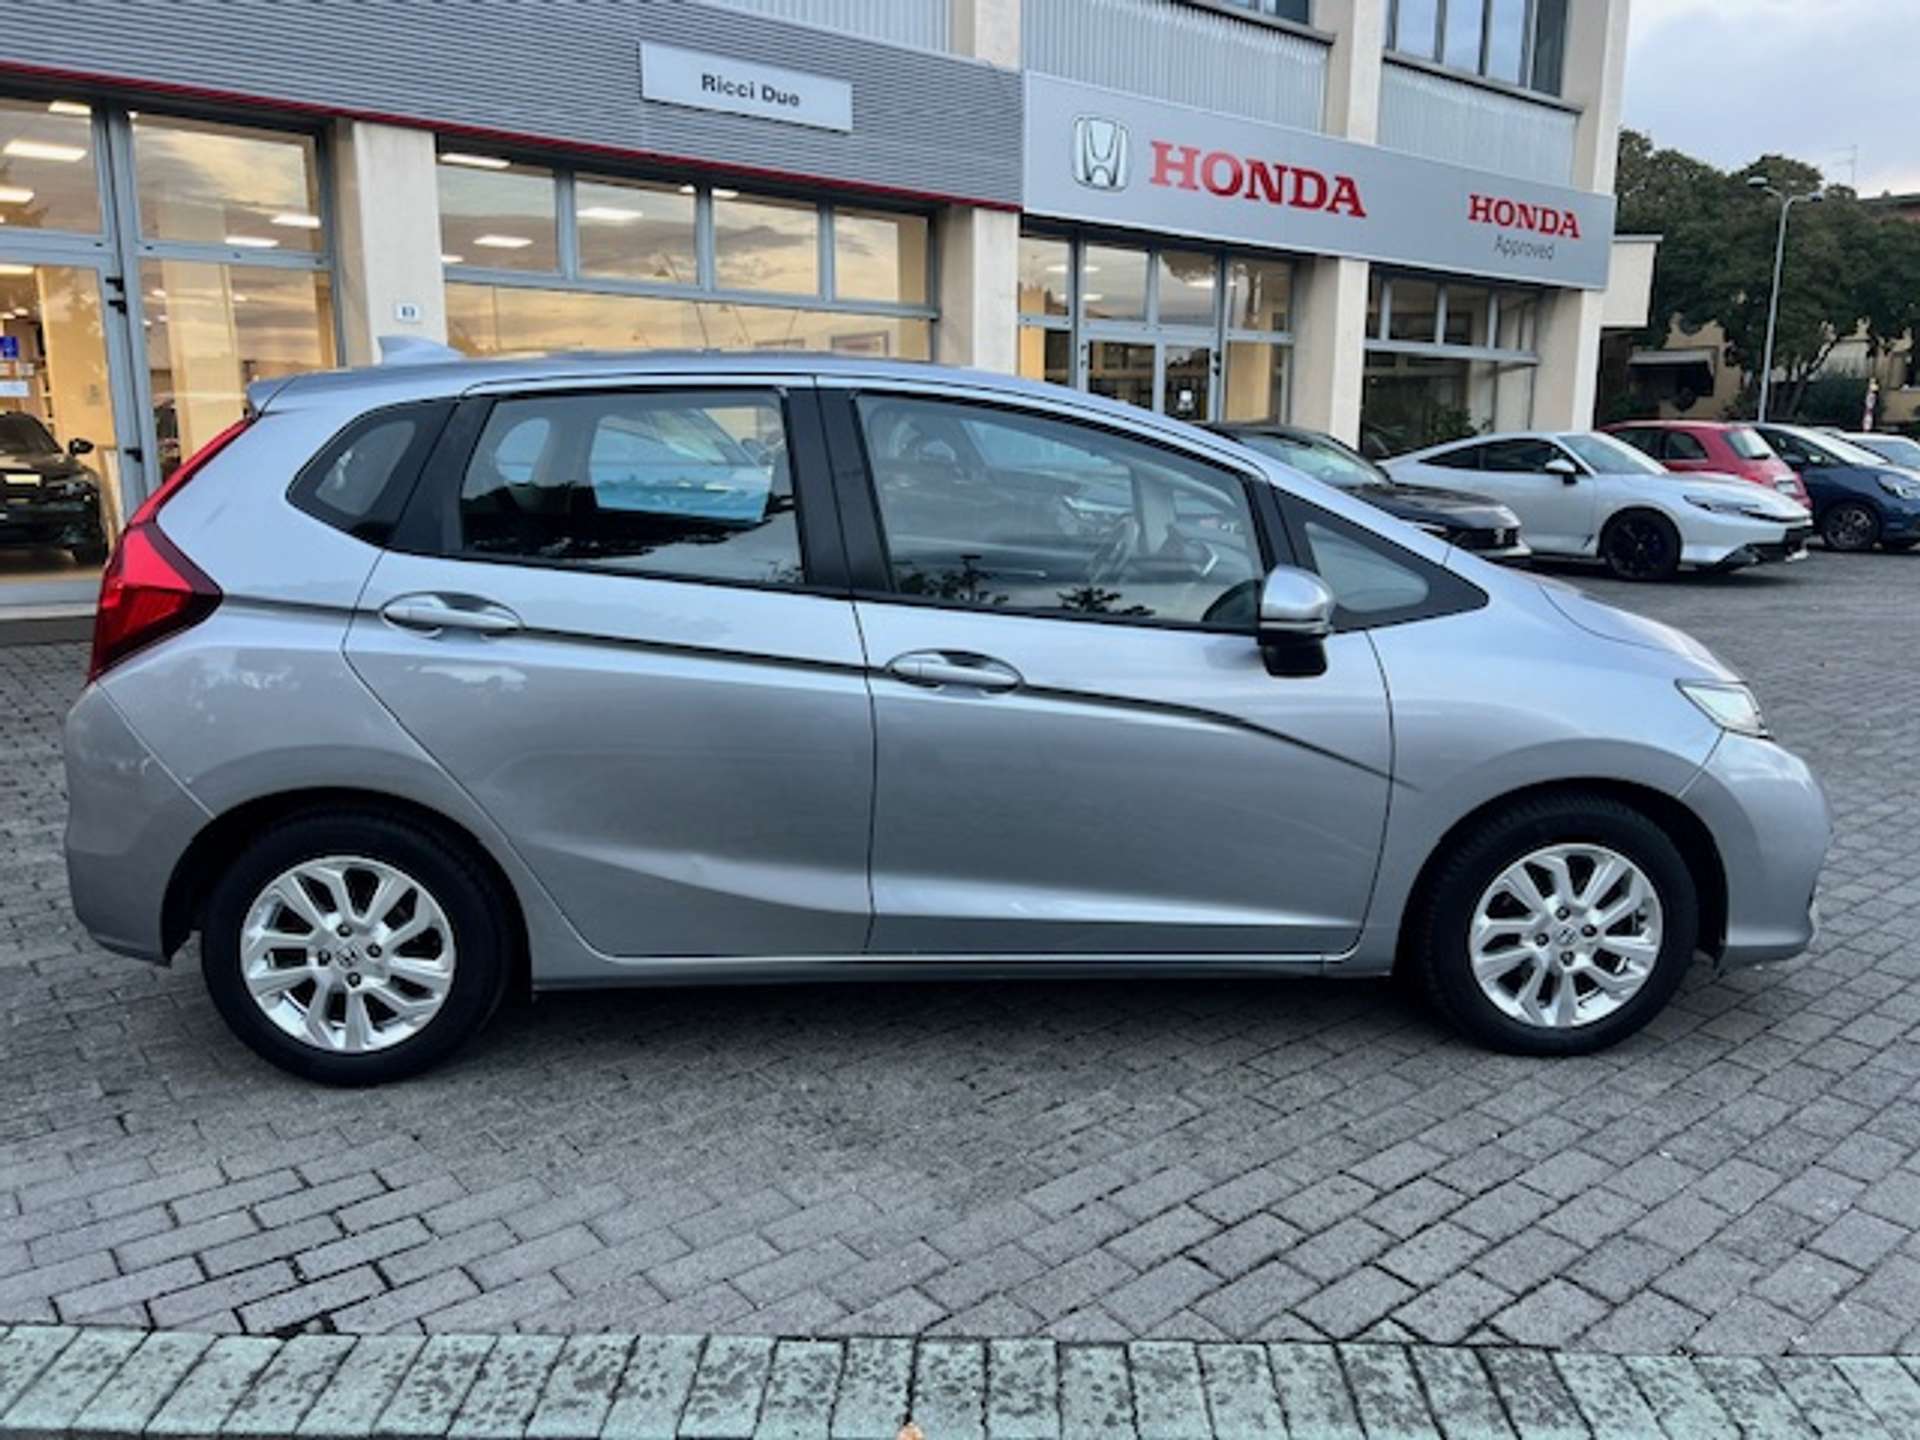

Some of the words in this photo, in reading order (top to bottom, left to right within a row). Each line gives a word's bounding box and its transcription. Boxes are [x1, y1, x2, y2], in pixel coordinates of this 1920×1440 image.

[702, 74, 755, 99] Ricci
[1149, 140, 1367, 218] HONDA
[1468, 194, 1580, 238] HONDA
[1494, 235, 1554, 261] Approved
